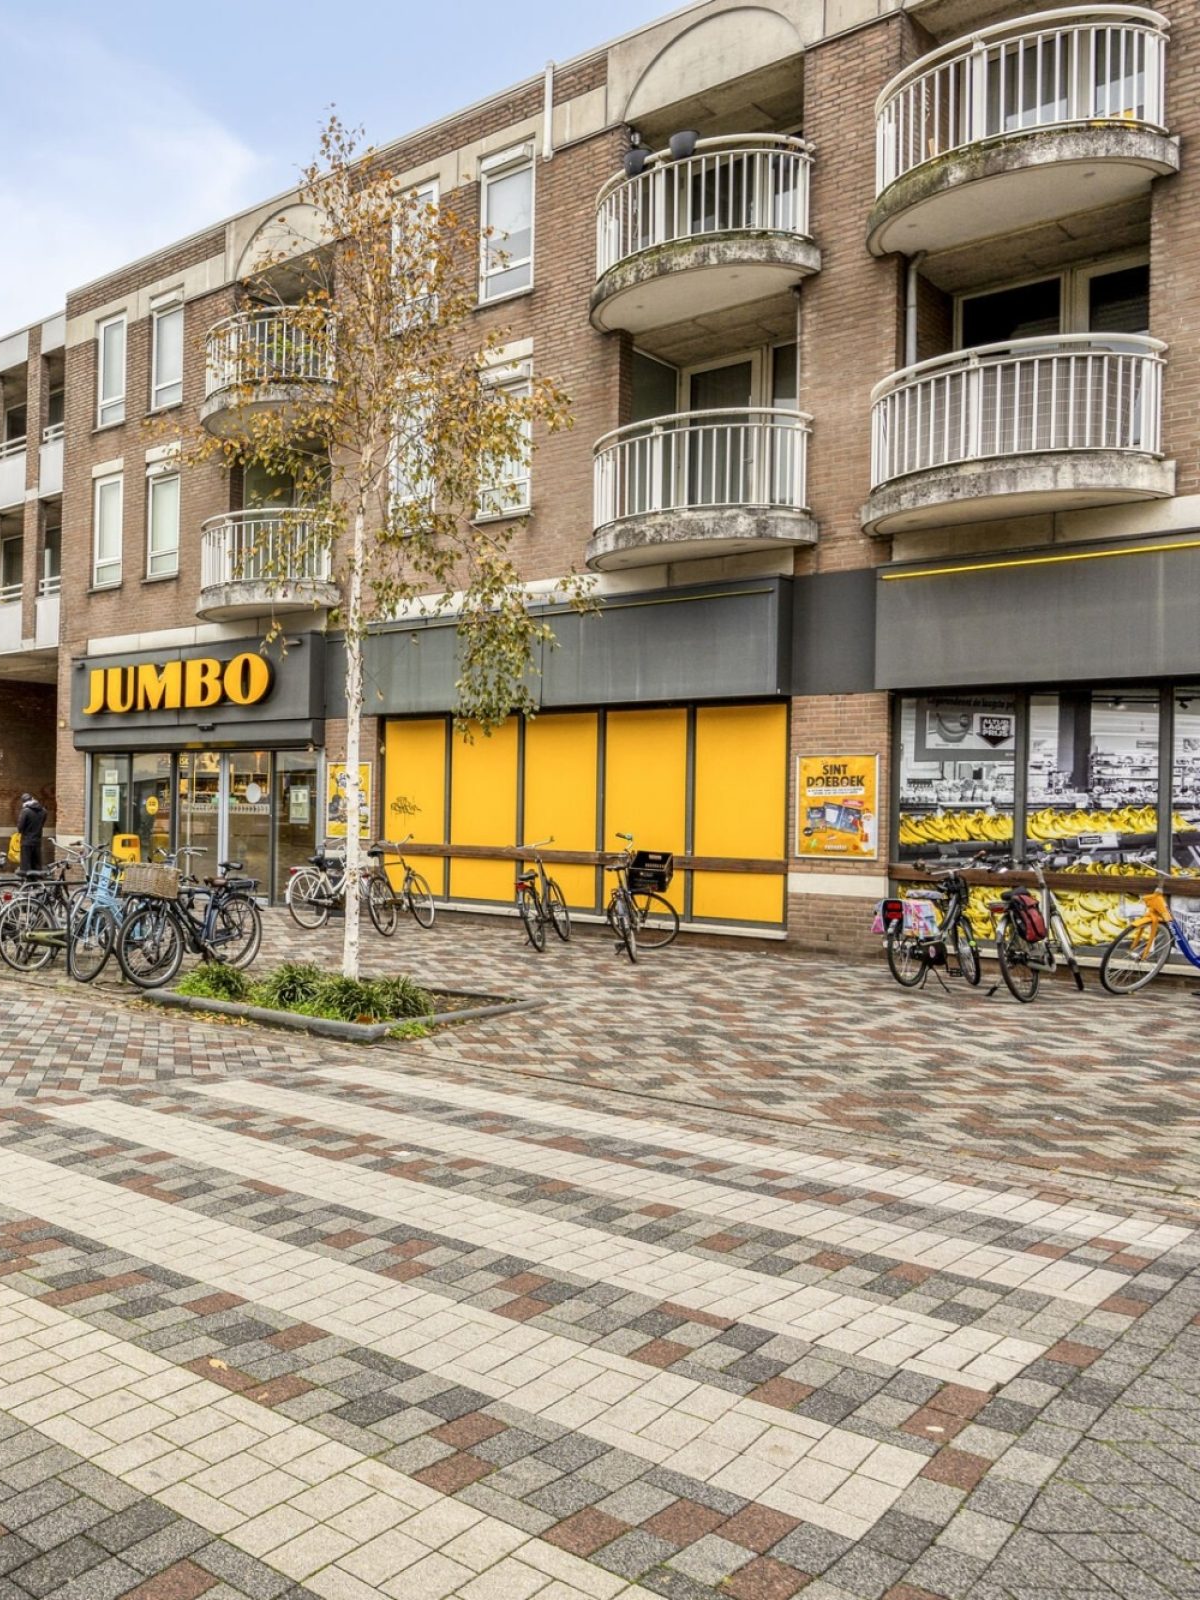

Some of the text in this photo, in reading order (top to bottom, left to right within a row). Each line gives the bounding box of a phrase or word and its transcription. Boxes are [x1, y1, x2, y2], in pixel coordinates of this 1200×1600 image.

[83, 652, 269, 715] JUMBO
[823, 764, 848, 775] SINT
[807, 776, 865, 787] DOEBOEK
